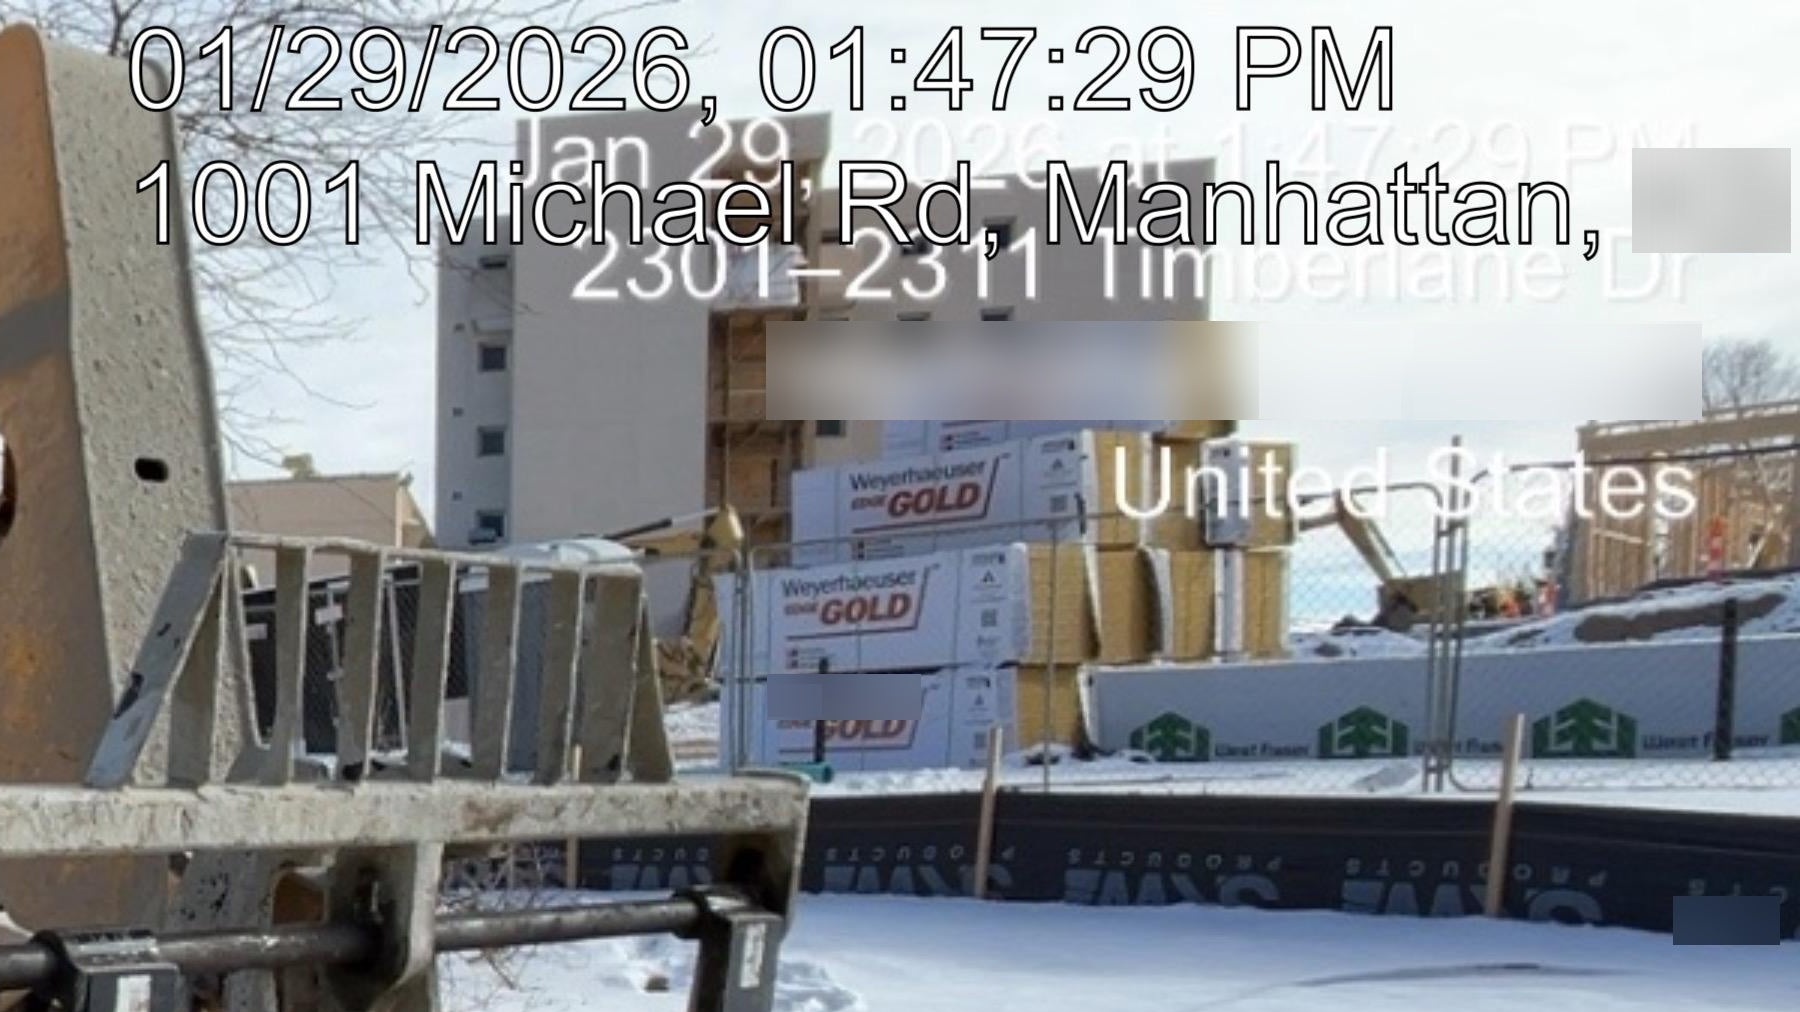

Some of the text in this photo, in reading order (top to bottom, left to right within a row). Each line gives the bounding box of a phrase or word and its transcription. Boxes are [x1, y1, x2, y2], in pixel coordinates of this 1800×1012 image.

[849, 460, 986, 492] Weyerhaeuser
[887, 482, 981, 517] GOLD
[781, 569, 917, 598] Weyerhaeuser
[819, 592, 912, 626] GOLD
[825, 844, 1016, 863] PODUCTS
